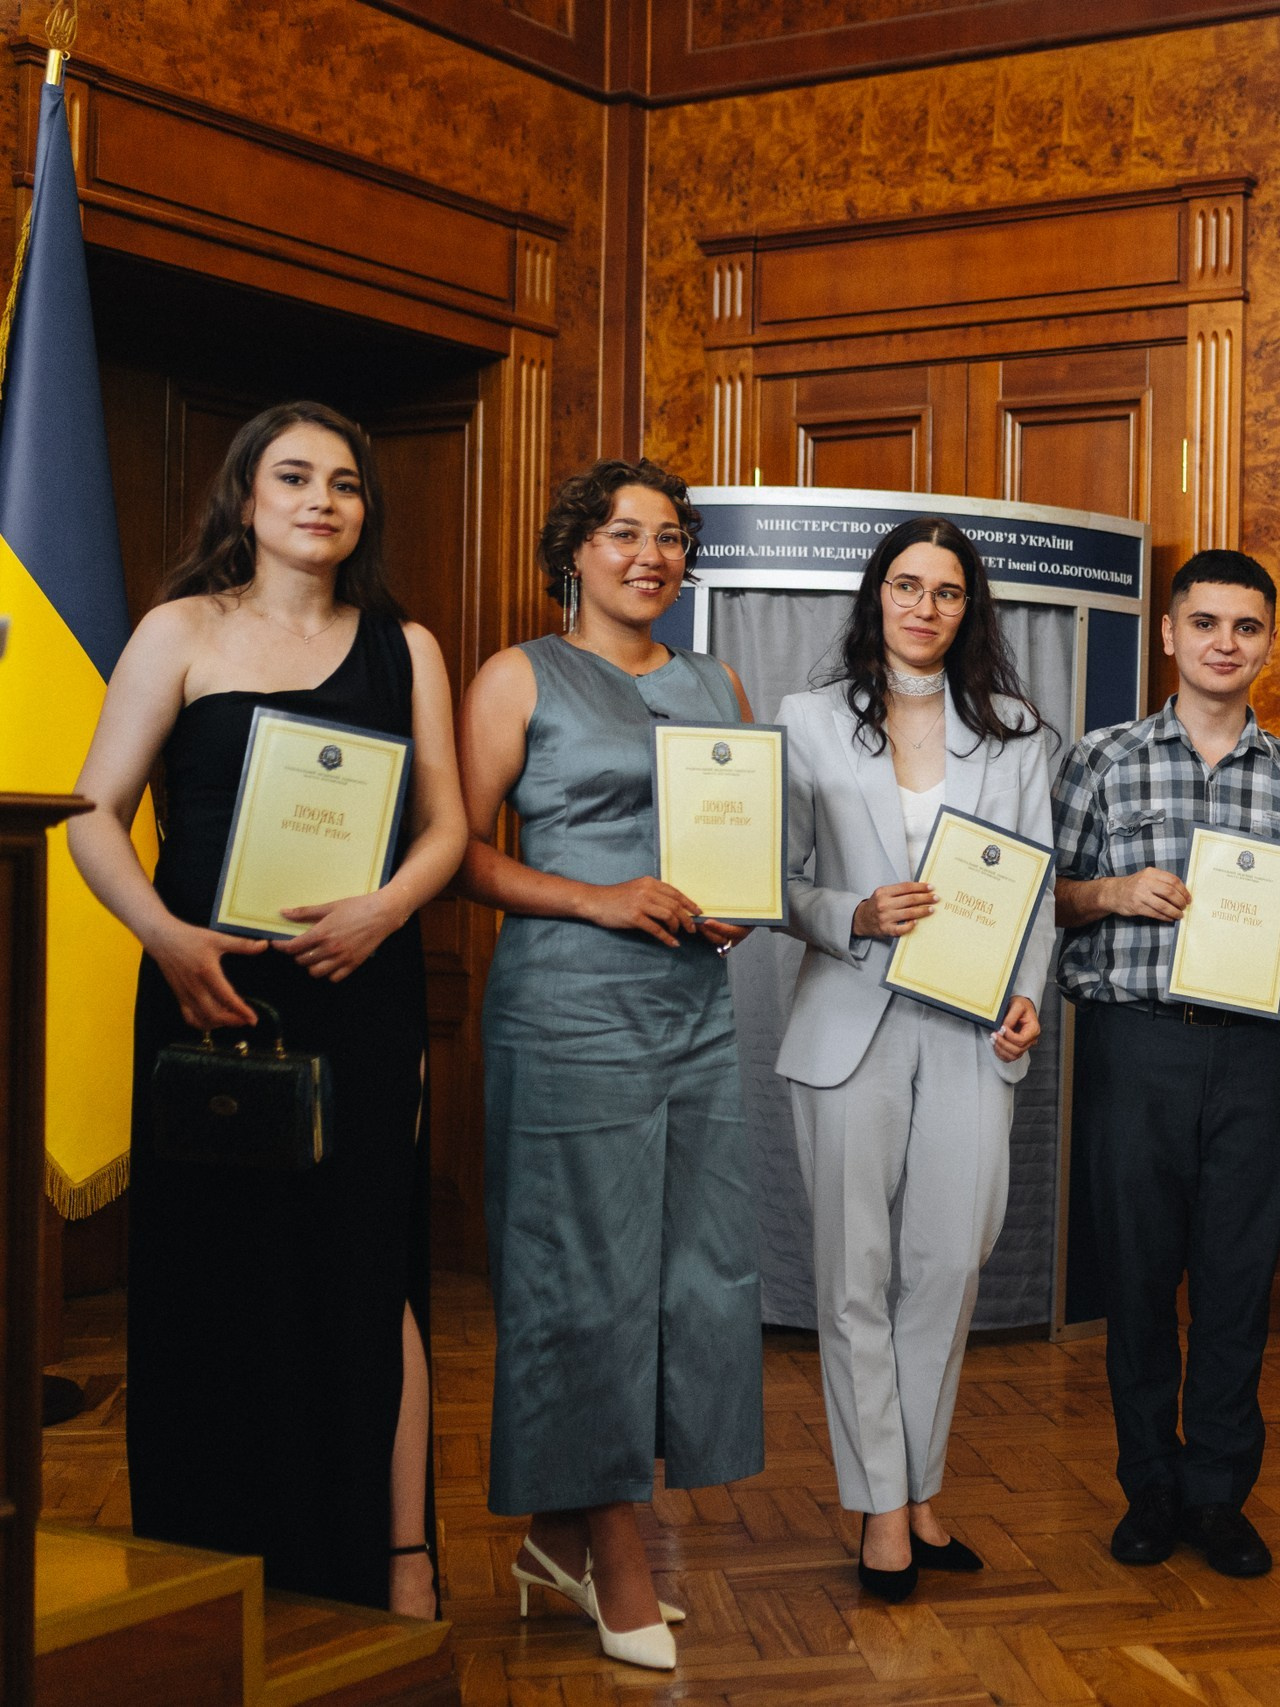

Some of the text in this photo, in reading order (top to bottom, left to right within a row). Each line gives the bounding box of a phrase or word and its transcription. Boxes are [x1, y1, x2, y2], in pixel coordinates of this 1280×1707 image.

[756, 518, 871, 533] МІНІСТЕРСТВО
[1020, 533, 1074, 551] УКРАЇНИ
[1007, 558, 1038, 573] імені
[1038, 561, 1133, 585] О.О.БОГОМОЛЬЦЯ
